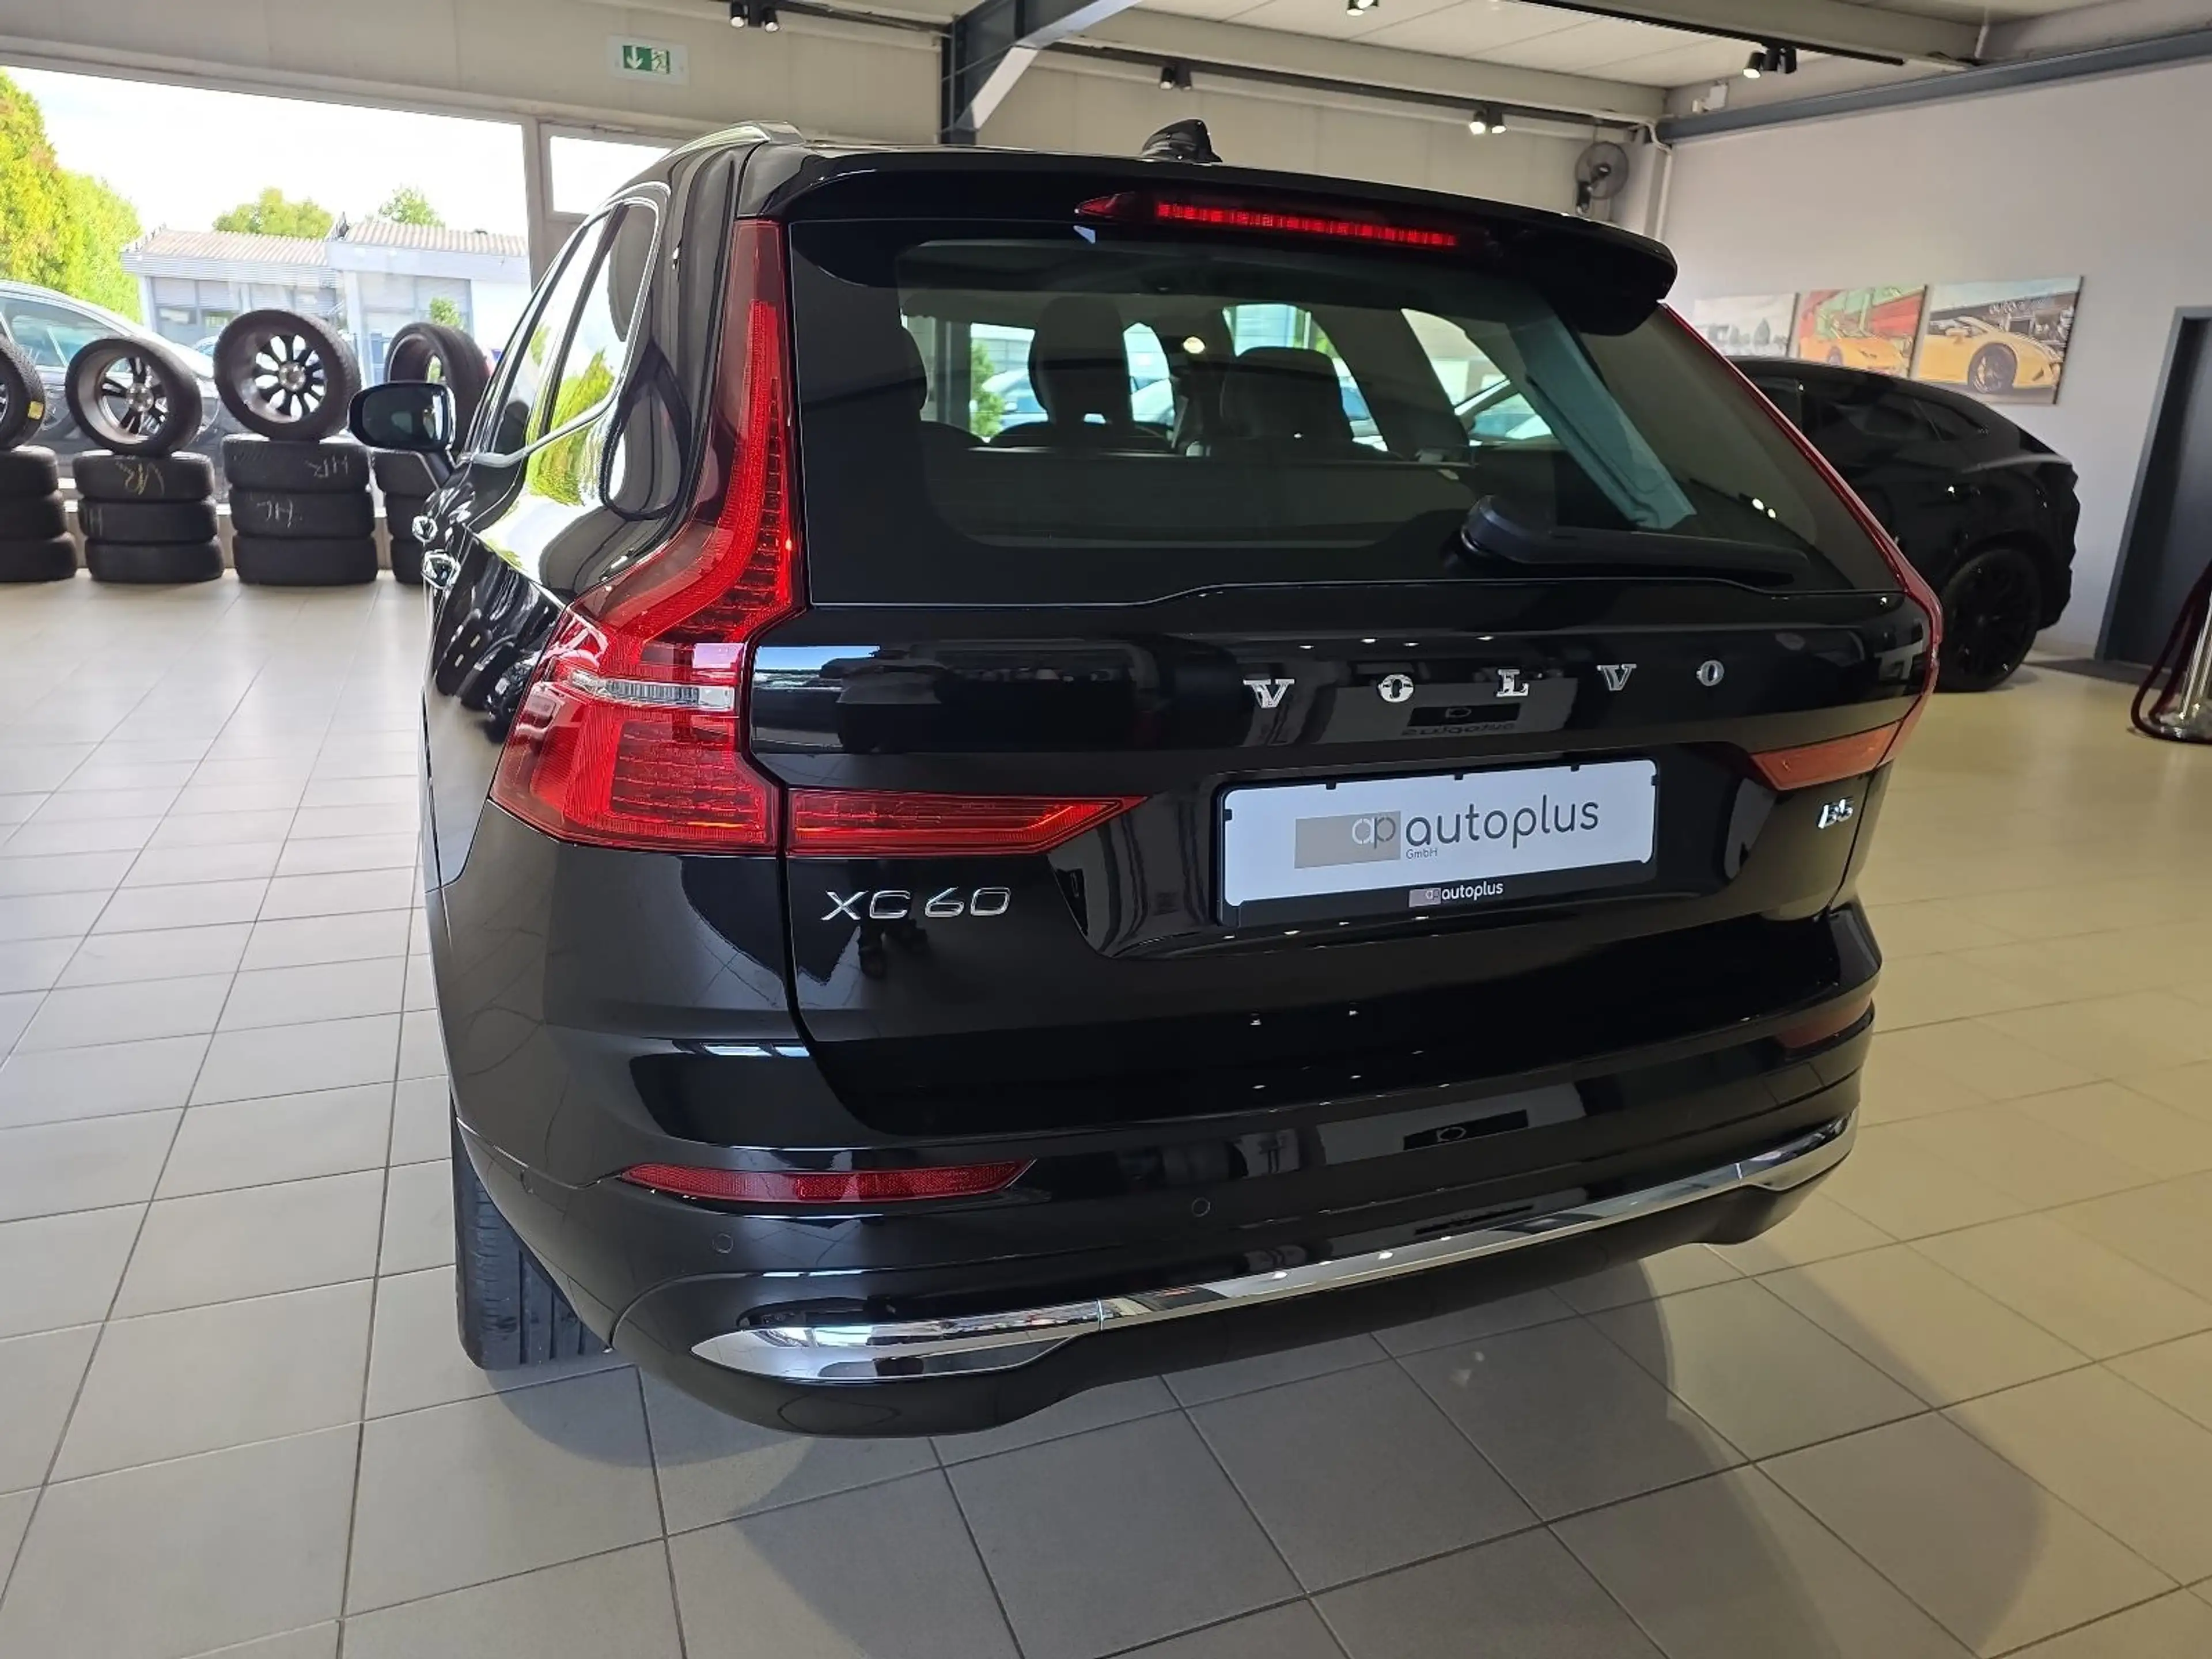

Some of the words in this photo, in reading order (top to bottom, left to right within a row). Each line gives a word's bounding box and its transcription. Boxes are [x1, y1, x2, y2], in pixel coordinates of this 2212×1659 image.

[1243, 660, 1725, 709] VOLVO
[1405, 794, 1600, 849] autoplus
[1406, 847, 1438, 859] GmbH
[1441, 881, 1504, 901] autoplus
